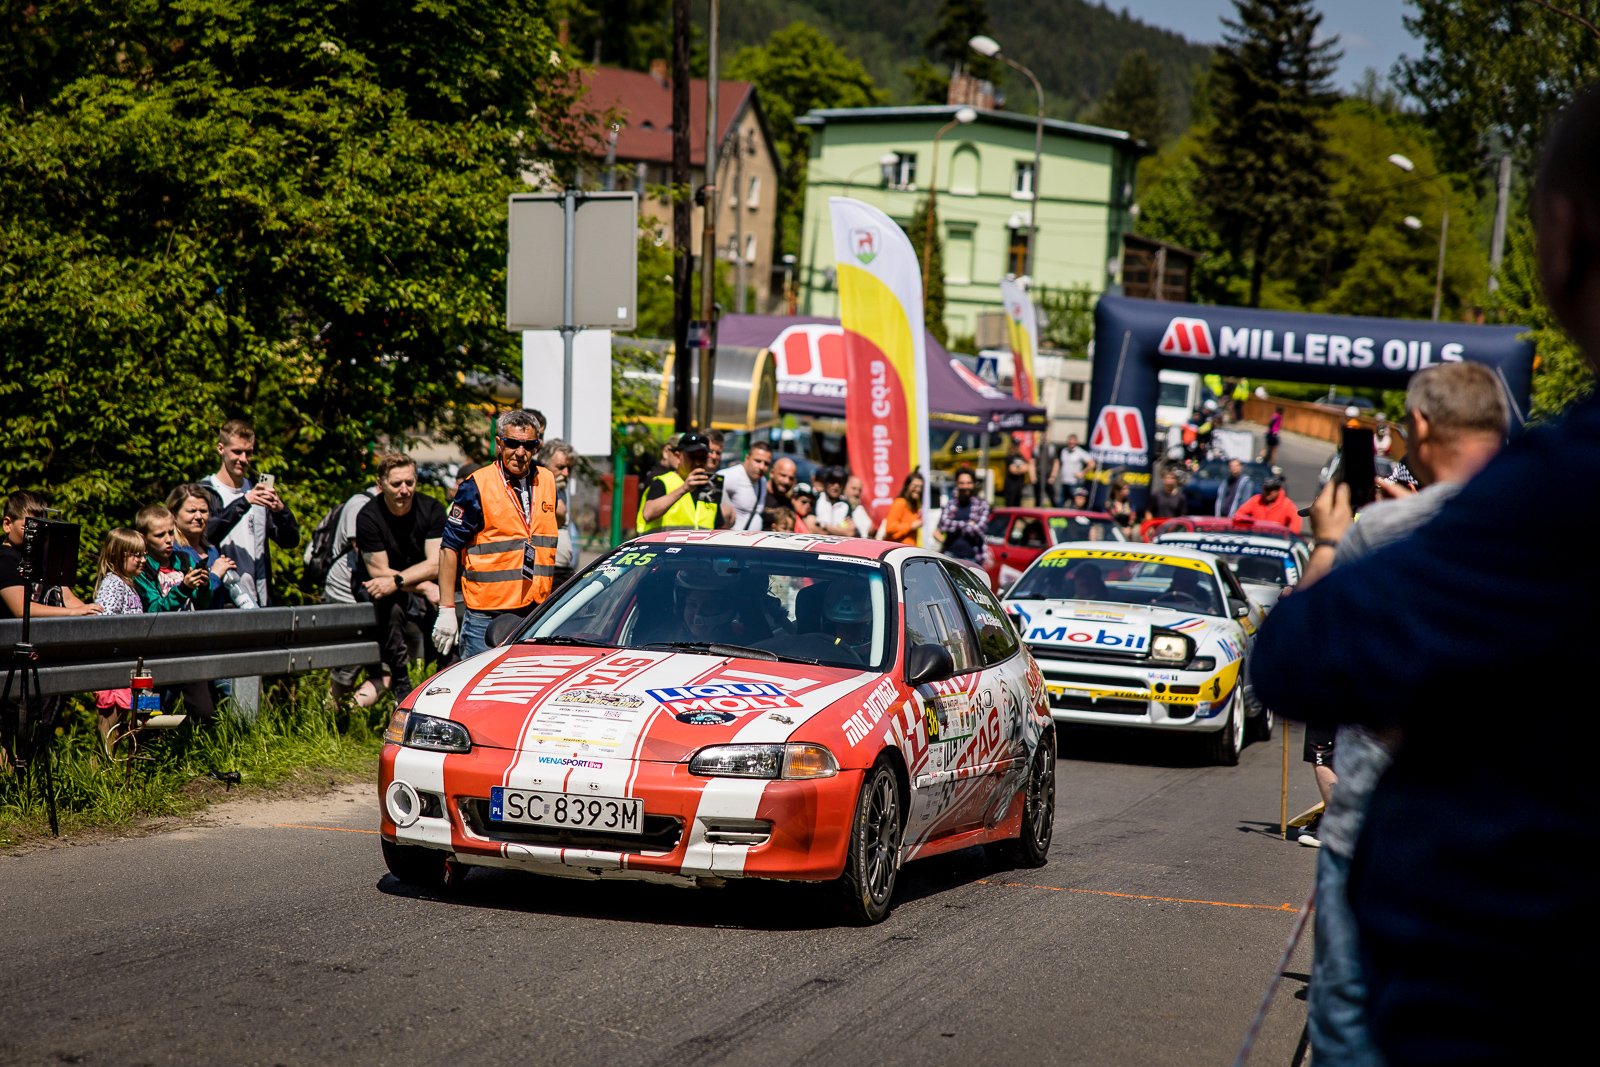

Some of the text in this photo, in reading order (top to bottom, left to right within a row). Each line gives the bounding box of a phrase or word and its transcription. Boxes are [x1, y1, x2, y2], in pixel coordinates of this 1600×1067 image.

[1220, 326, 1375, 367] MILLERS
[870, 360, 894, 507] Jelenia Góra
[615, 552, 658, 566] R5
[1200, 544, 1239, 554] RALLY
[1241, 546, 1290, 559] ACTION
[1029, 627, 1146, 649] Mobil
[561, 657, 655, 693] STA
[652, 683, 779, 700] LIQUI
[672, 696, 794, 712] MOLY
[926, 707, 938, 737] 38
[538, 756, 588, 768] WENASPORT
[954, 707, 999, 797] STAG
[492, 807, 502, 816] PL
[507, 792, 638, 830] SC 8393M
